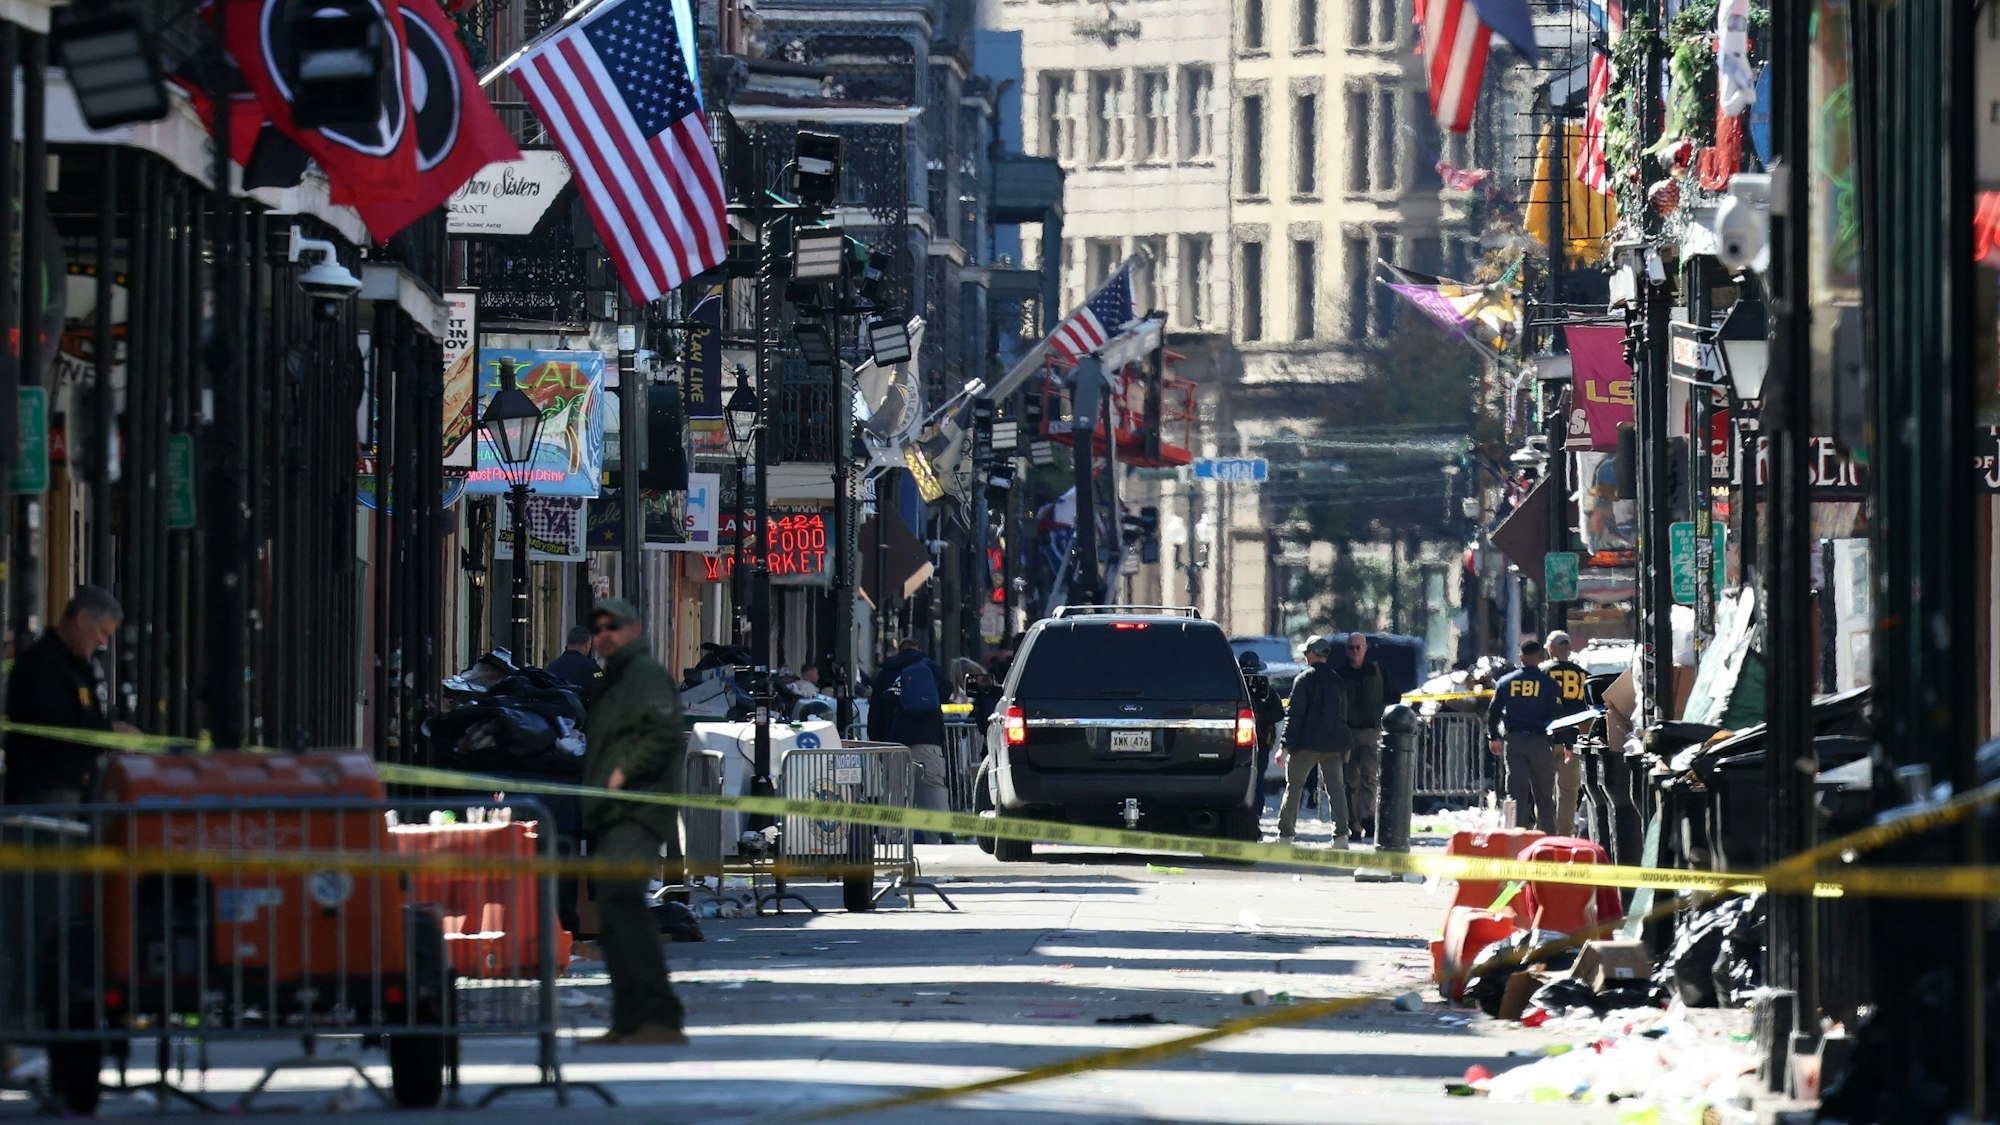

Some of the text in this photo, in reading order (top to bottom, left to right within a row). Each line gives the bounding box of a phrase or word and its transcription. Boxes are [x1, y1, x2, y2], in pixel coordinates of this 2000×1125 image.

[492, 166, 541, 198] Sisters
[450, 203, 488, 214] RANT
[689, 367, 705, 403] LIKE
[1585, 380, 1634, 405] LS
[536, 469, 564, 481] Drink
[768, 528, 825, 551] FOOD
[1510, 680, 1540, 697] FBI
[1549, 669, 1586, 701] FBI
[1133, 736, 1149, 747] 476
